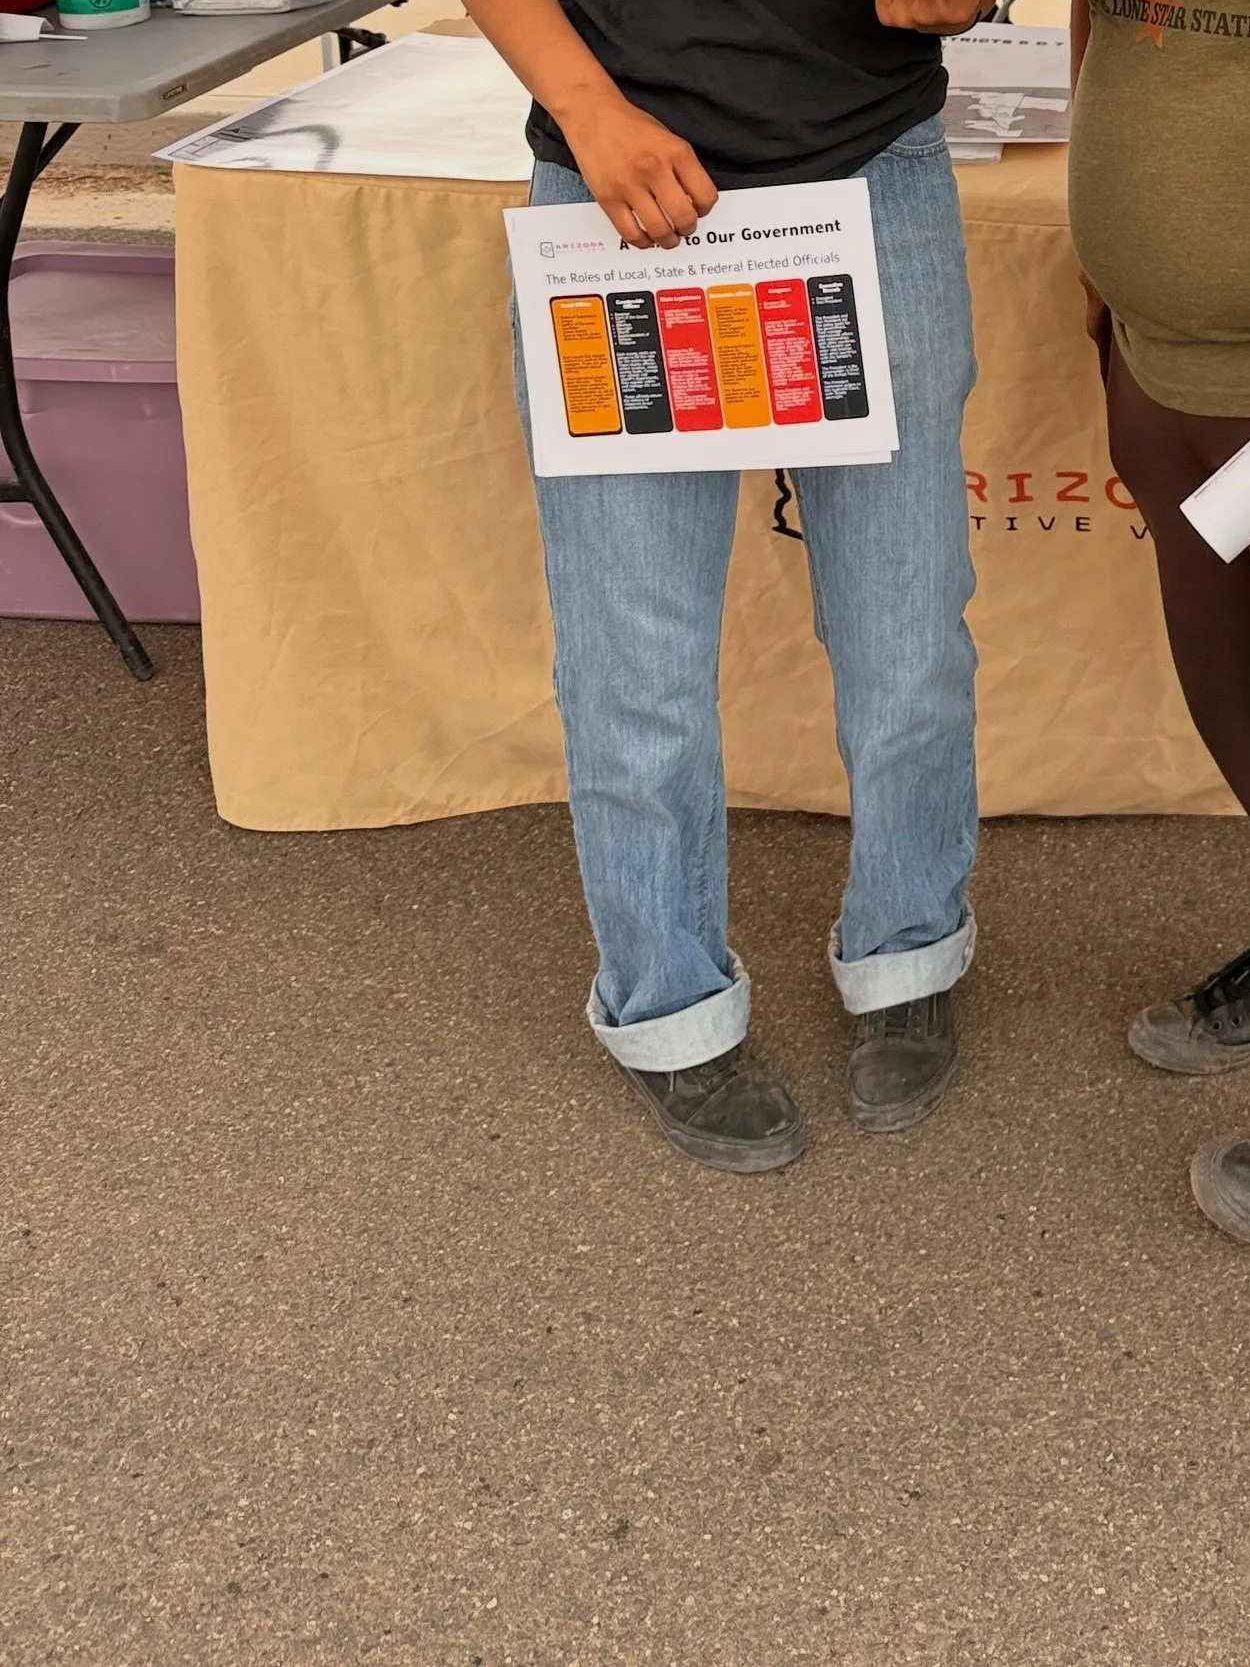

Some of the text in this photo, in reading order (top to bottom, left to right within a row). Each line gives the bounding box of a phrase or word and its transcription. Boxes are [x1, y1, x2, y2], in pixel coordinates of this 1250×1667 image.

[1150, 1, 1188, 31] STAR
[684, 235, 701, 246] to
[706, 231, 736, 244] Our
[741, 219, 842, 241] Government
[546, 251, 841, 285] The Roles of Local, State & Federal Elected Officials
[970, 515, 1092, 532] TIVE
